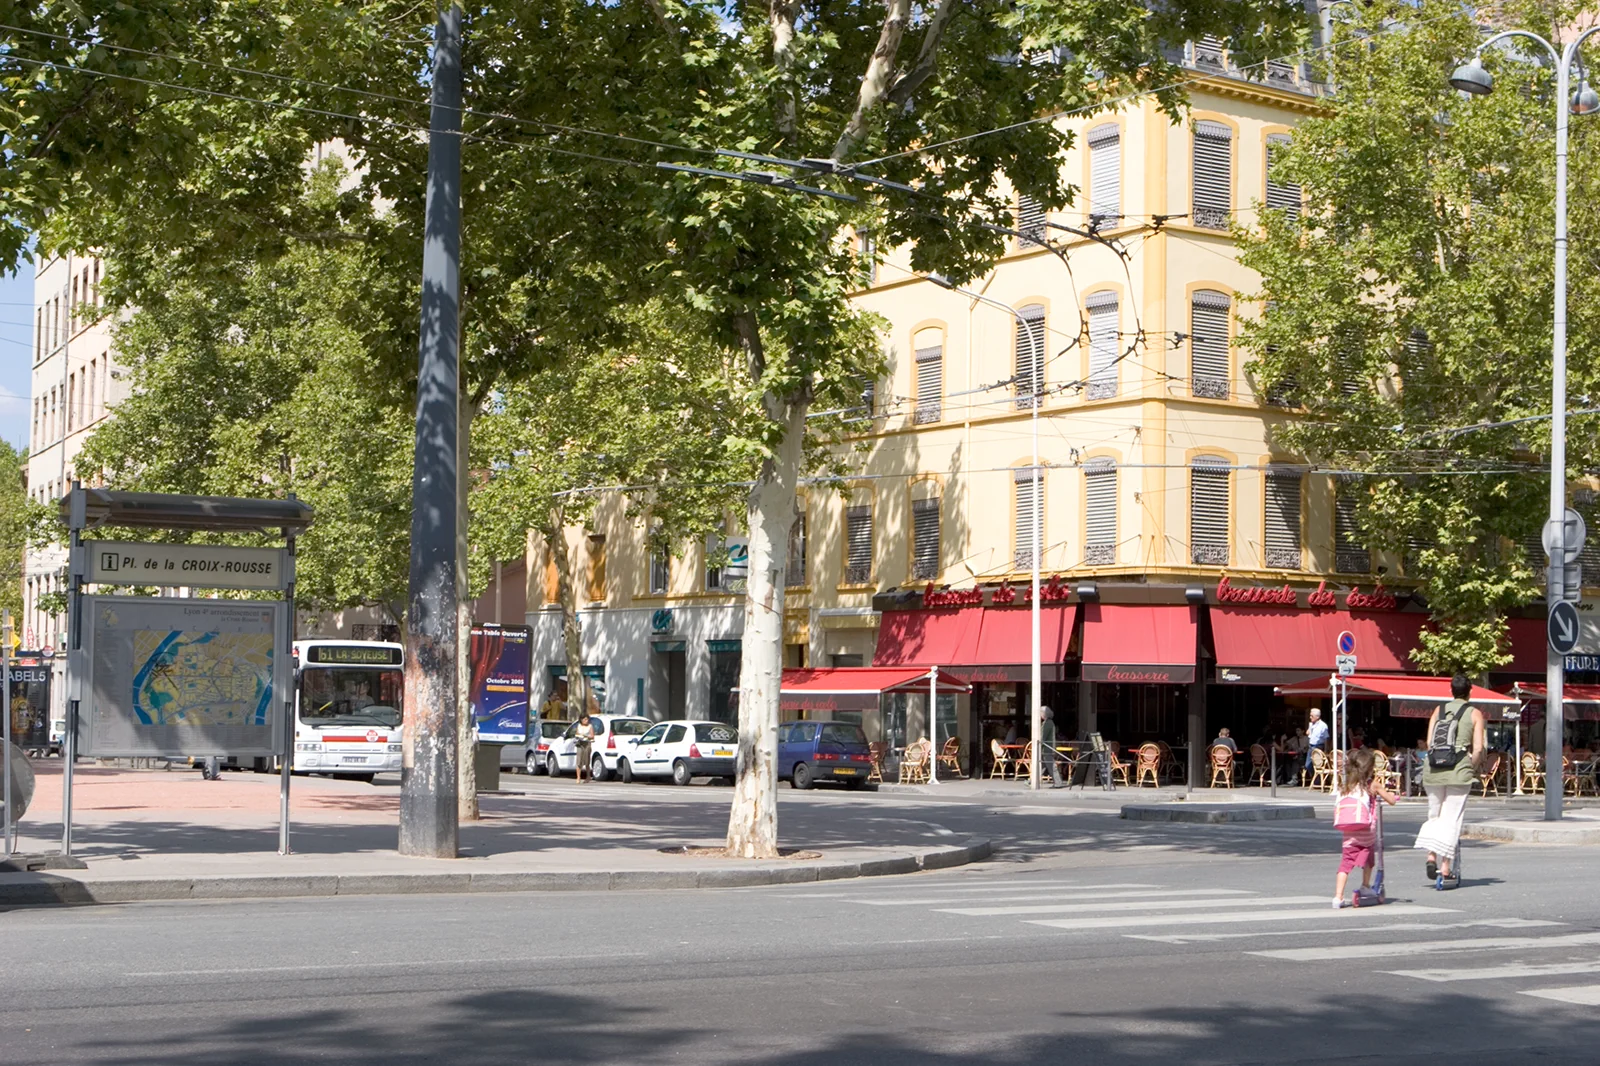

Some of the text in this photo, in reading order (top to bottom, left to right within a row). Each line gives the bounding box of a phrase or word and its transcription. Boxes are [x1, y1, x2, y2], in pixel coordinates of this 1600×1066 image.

[122, 557, 137, 569] Pl.
[144, 558, 158, 570] de
[164, 559, 174, 570] la
[182, 560, 272, 574] CROIX-ROUSSE
[991, 578, 1016, 602] des
[1216, 576, 1296, 604] brasserie
[1308, 580, 1336, 605] des
[184, 608, 200, 616] Lyon
[210, 609, 260, 617] arrondissement
[320, 648, 333, 660] 61
[336, 649, 347, 659] LA
[1564, 656, 1599, 671] FFURE
[1107, 666, 1170, 680] brasserie
